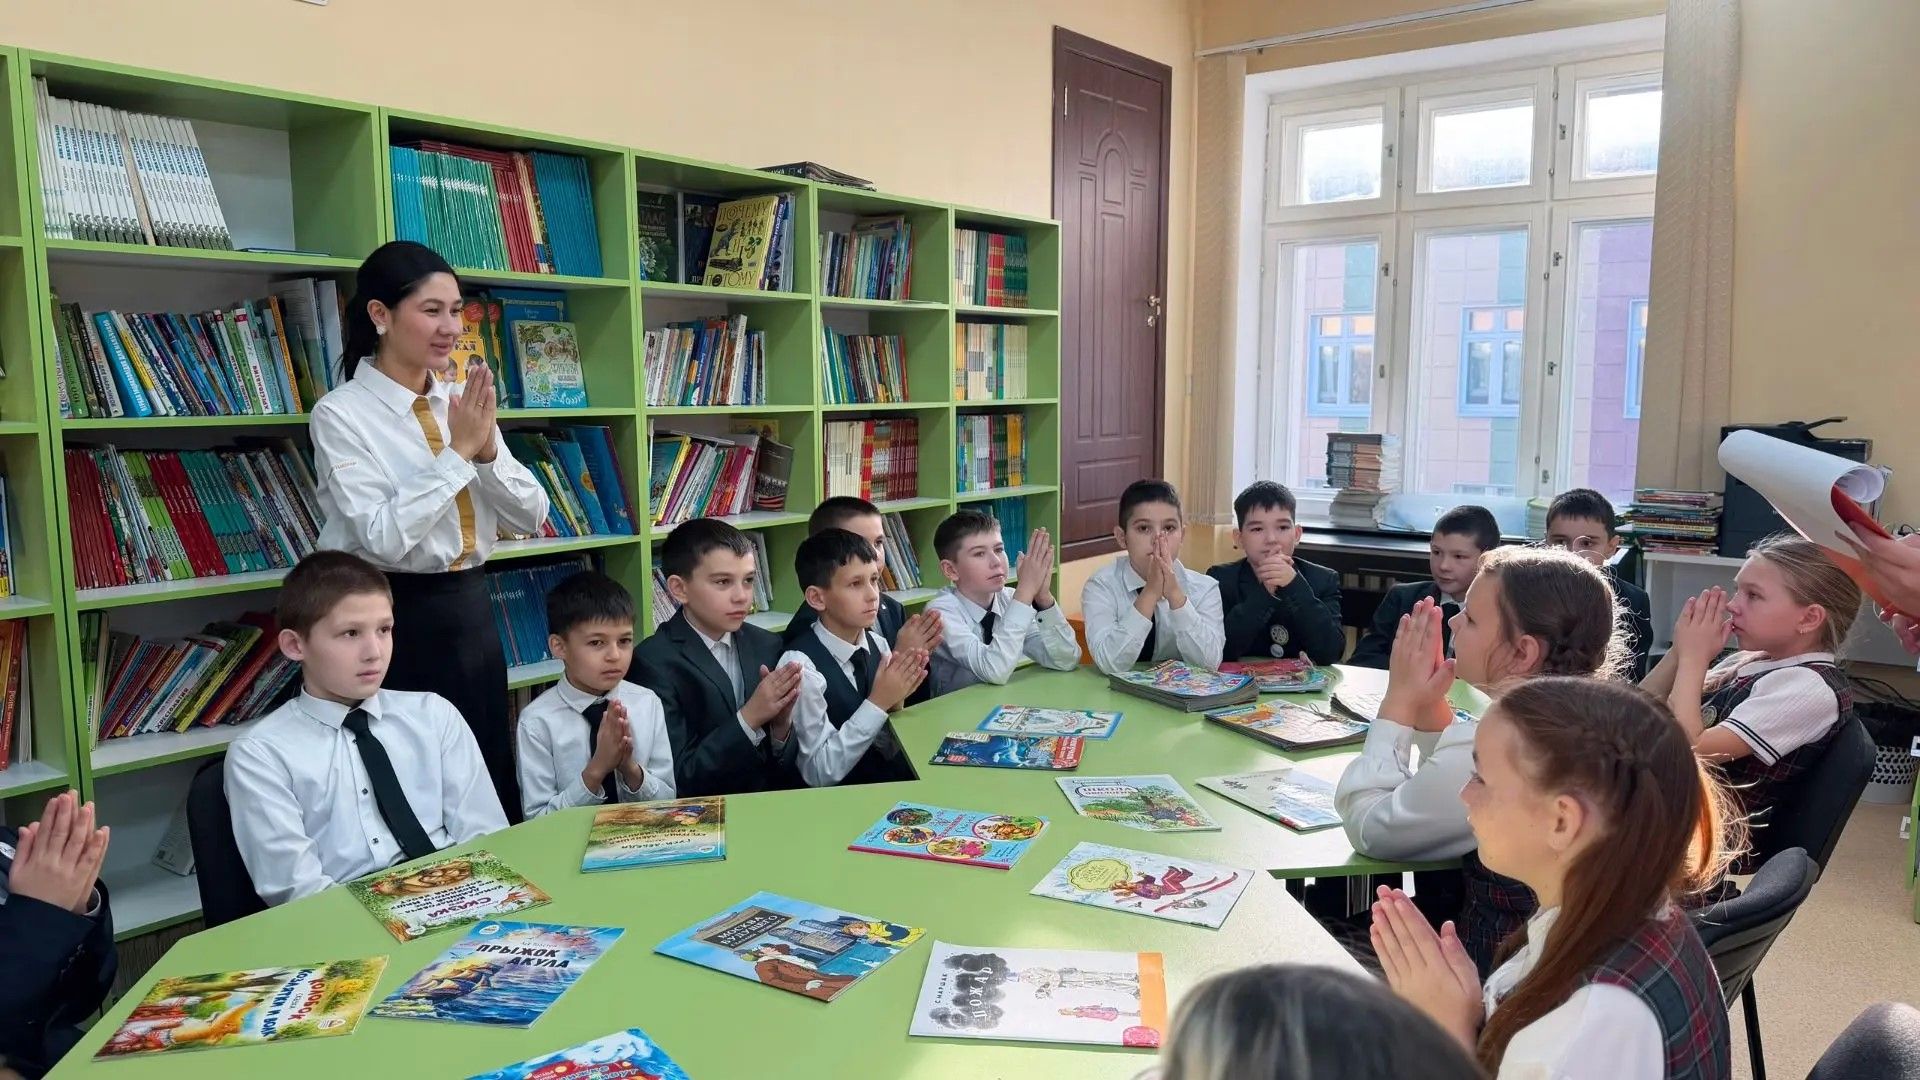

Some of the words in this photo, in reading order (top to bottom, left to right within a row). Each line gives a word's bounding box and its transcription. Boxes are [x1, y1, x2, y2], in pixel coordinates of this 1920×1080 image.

[719, 201, 770, 221] ПОЧЕМУ
[704, 270, 756, 286] ПОТОМУ
[154, 686, 188, 729] ХРЕСТОМАТИЯ
[425, 896, 493, 918] СКАЗКА
[717, 917, 763, 938] МОСКВА
[473, 944, 562, 957] ПРЫЖОК
[505, 956, 573, 968] АКУЛА
[270, 968, 314, 1007] КОЗЛЯТКИ
[968, 966, 993, 1017] ПОЖАР
[287, 978, 325, 1019] КОЛОБОК
[258, 1017, 277, 1036] ВОЛК
